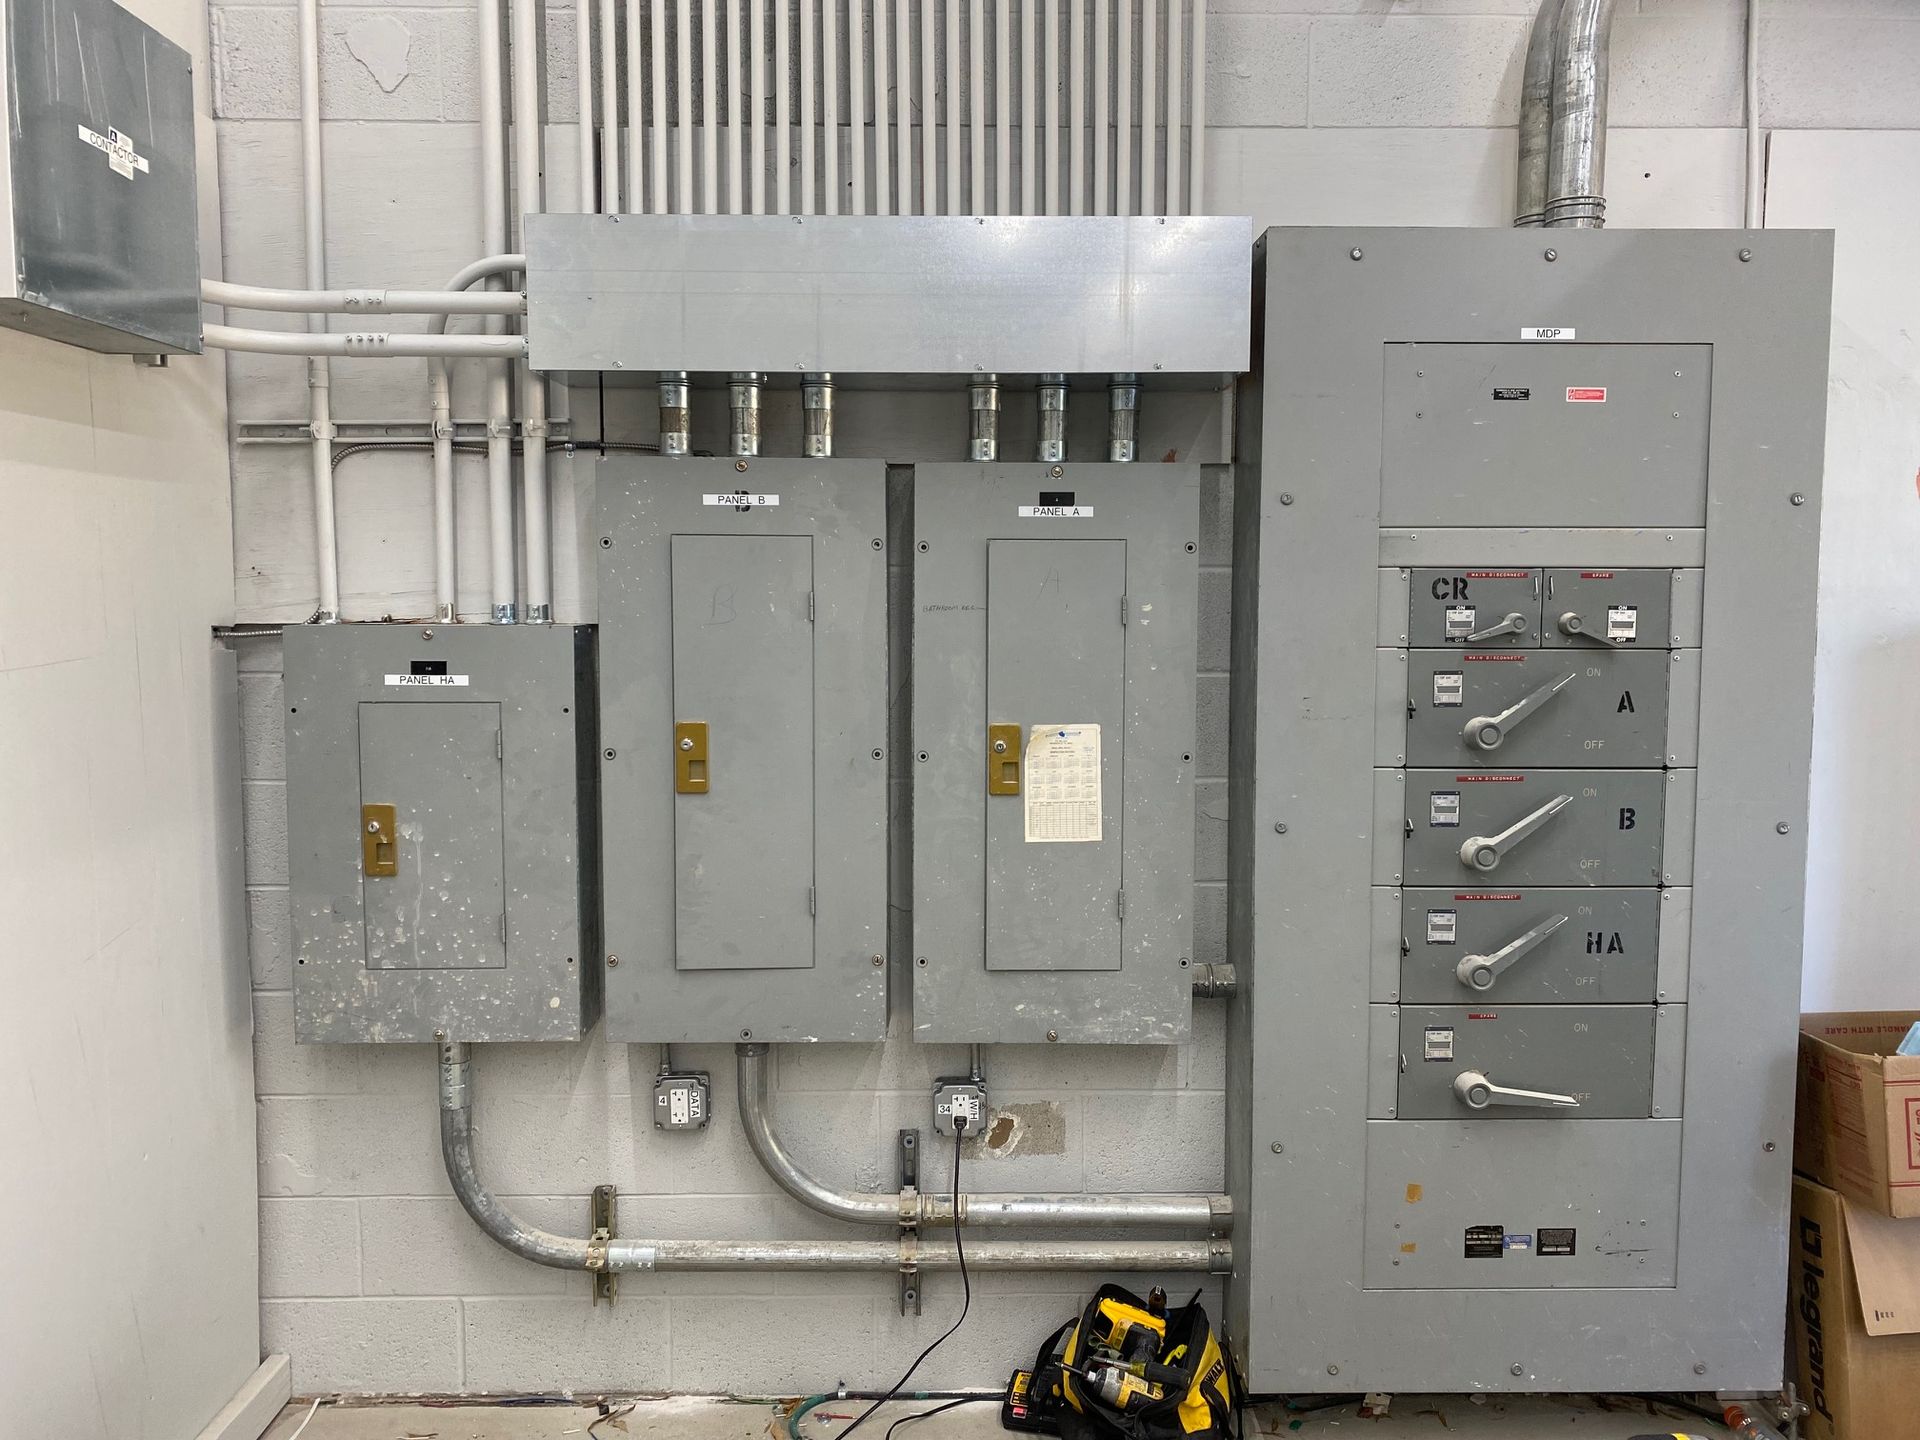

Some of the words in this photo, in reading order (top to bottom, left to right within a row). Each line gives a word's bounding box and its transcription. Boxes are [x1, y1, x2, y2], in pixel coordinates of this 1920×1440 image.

[89, 132, 139, 166] CONTACTOR
[1536, 329, 1561, 338] MDP
[717, 495, 752, 505] PANEL
[758, 495, 766, 505] B
[1033, 507, 1067, 516] PANEL
[1072, 507, 1080, 516] A
[1431, 577, 1469, 600] CR
[1586, 667, 1601, 677] ON
[399, 675, 434, 685] PANEL
[440, 675, 455, 685] HA
[1617, 690, 1635, 713] A
[1584, 740, 1605, 750] OFF
[1582, 787, 1598, 797] ON
[1619, 807, 1636, 830] B
[1580, 859, 1601, 869] OFF
[1577, 905, 1593, 915] ON
[1586, 931, 1624, 954] HA
[1575, 976, 1597, 986] OFF
[1573, 1022, 1589, 1033] ON
[1823, 1026, 1848, 1036] CARE
[1851, 1026, 1874, 1035] WITH
[659, 1096, 667, 1105] 4
[1571, 1092, 1592, 1101] OFF
[690, 1090, 700, 1117] DATA
[939, 1104, 951, 1114] 34
[1801, 1260, 1835, 1425] legrand
